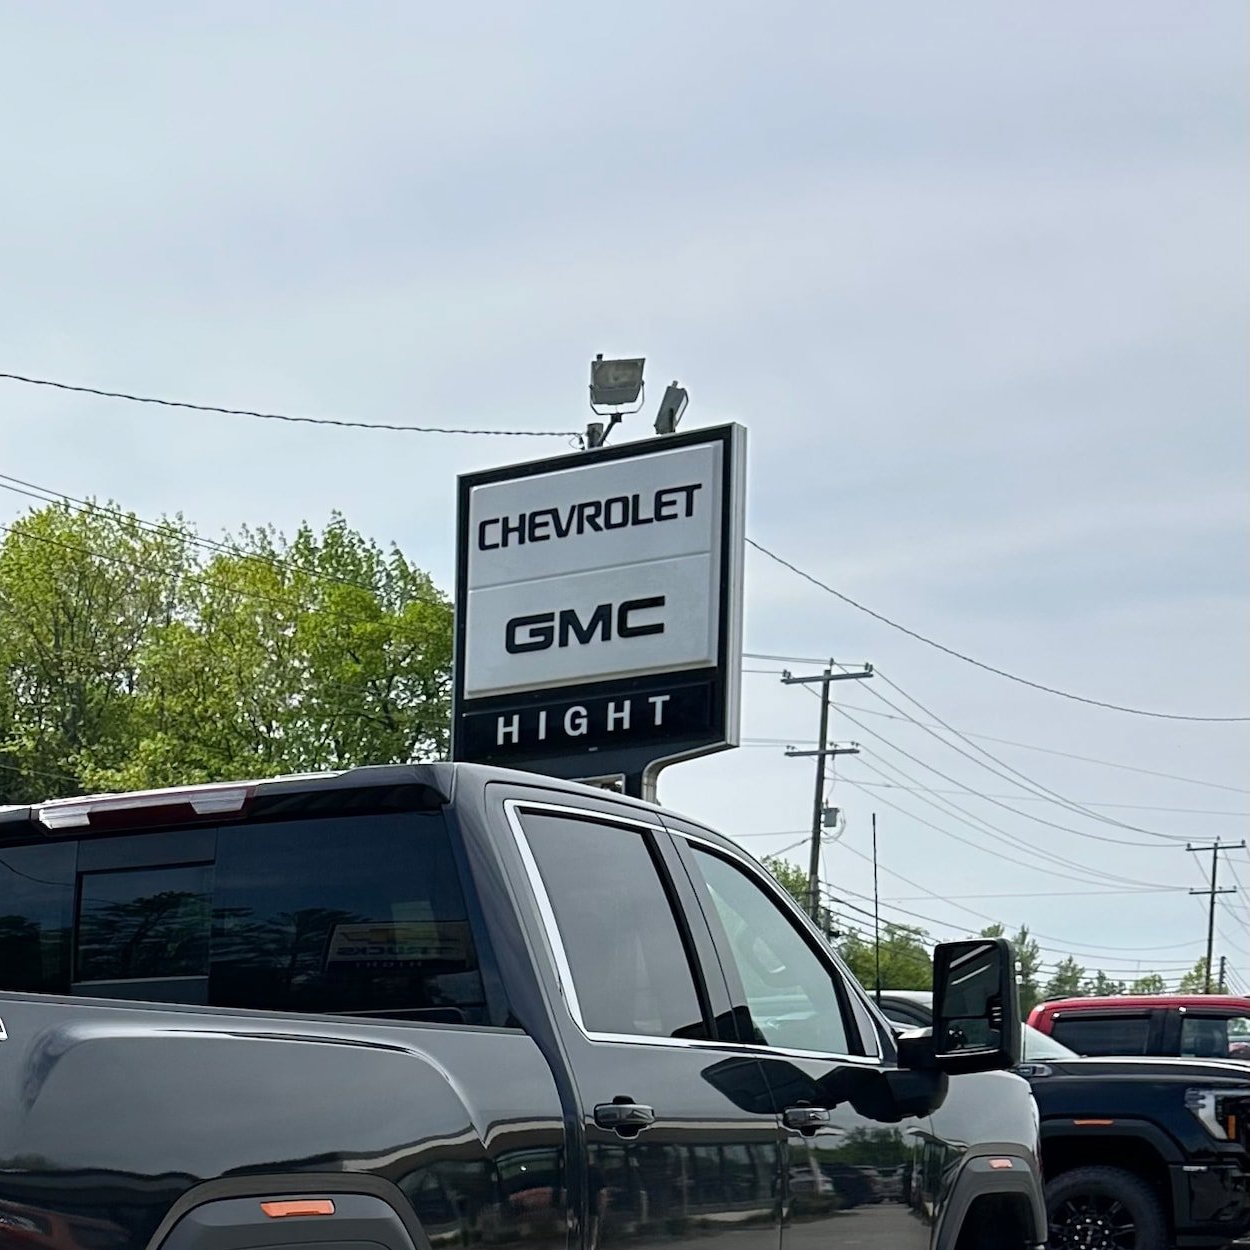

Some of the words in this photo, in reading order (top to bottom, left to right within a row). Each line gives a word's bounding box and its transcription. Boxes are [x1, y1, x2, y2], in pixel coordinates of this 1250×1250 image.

[478, 483, 702, 551] CHEVROLET
[505, 595, 666, 655] GMC
[497, 694, 670, 746] HIGHT
